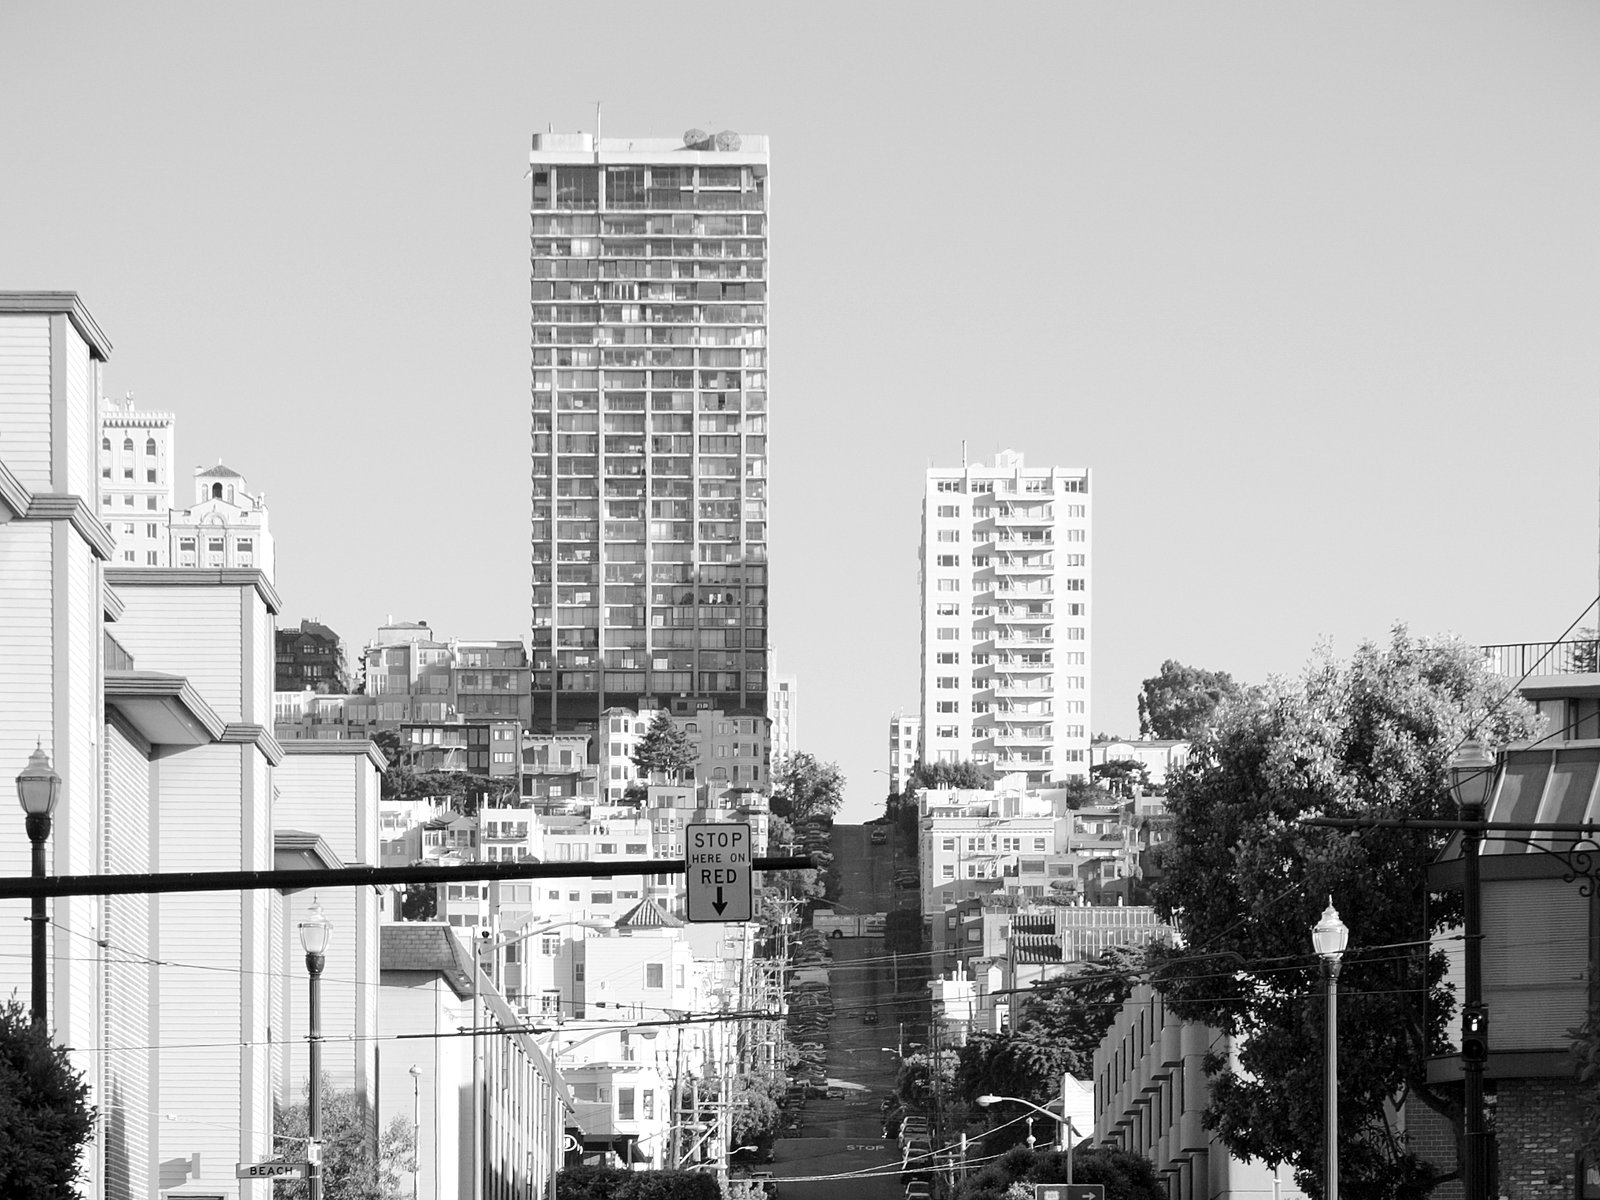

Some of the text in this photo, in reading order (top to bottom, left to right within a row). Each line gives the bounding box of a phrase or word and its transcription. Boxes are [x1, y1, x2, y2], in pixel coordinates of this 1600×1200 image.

[694, 832, 742, 848] STOP
[692, 853, 745, 863] HERE ON
[701, 869, 737, 884] RED
[250, 1166, 293, 1176] BEACH
